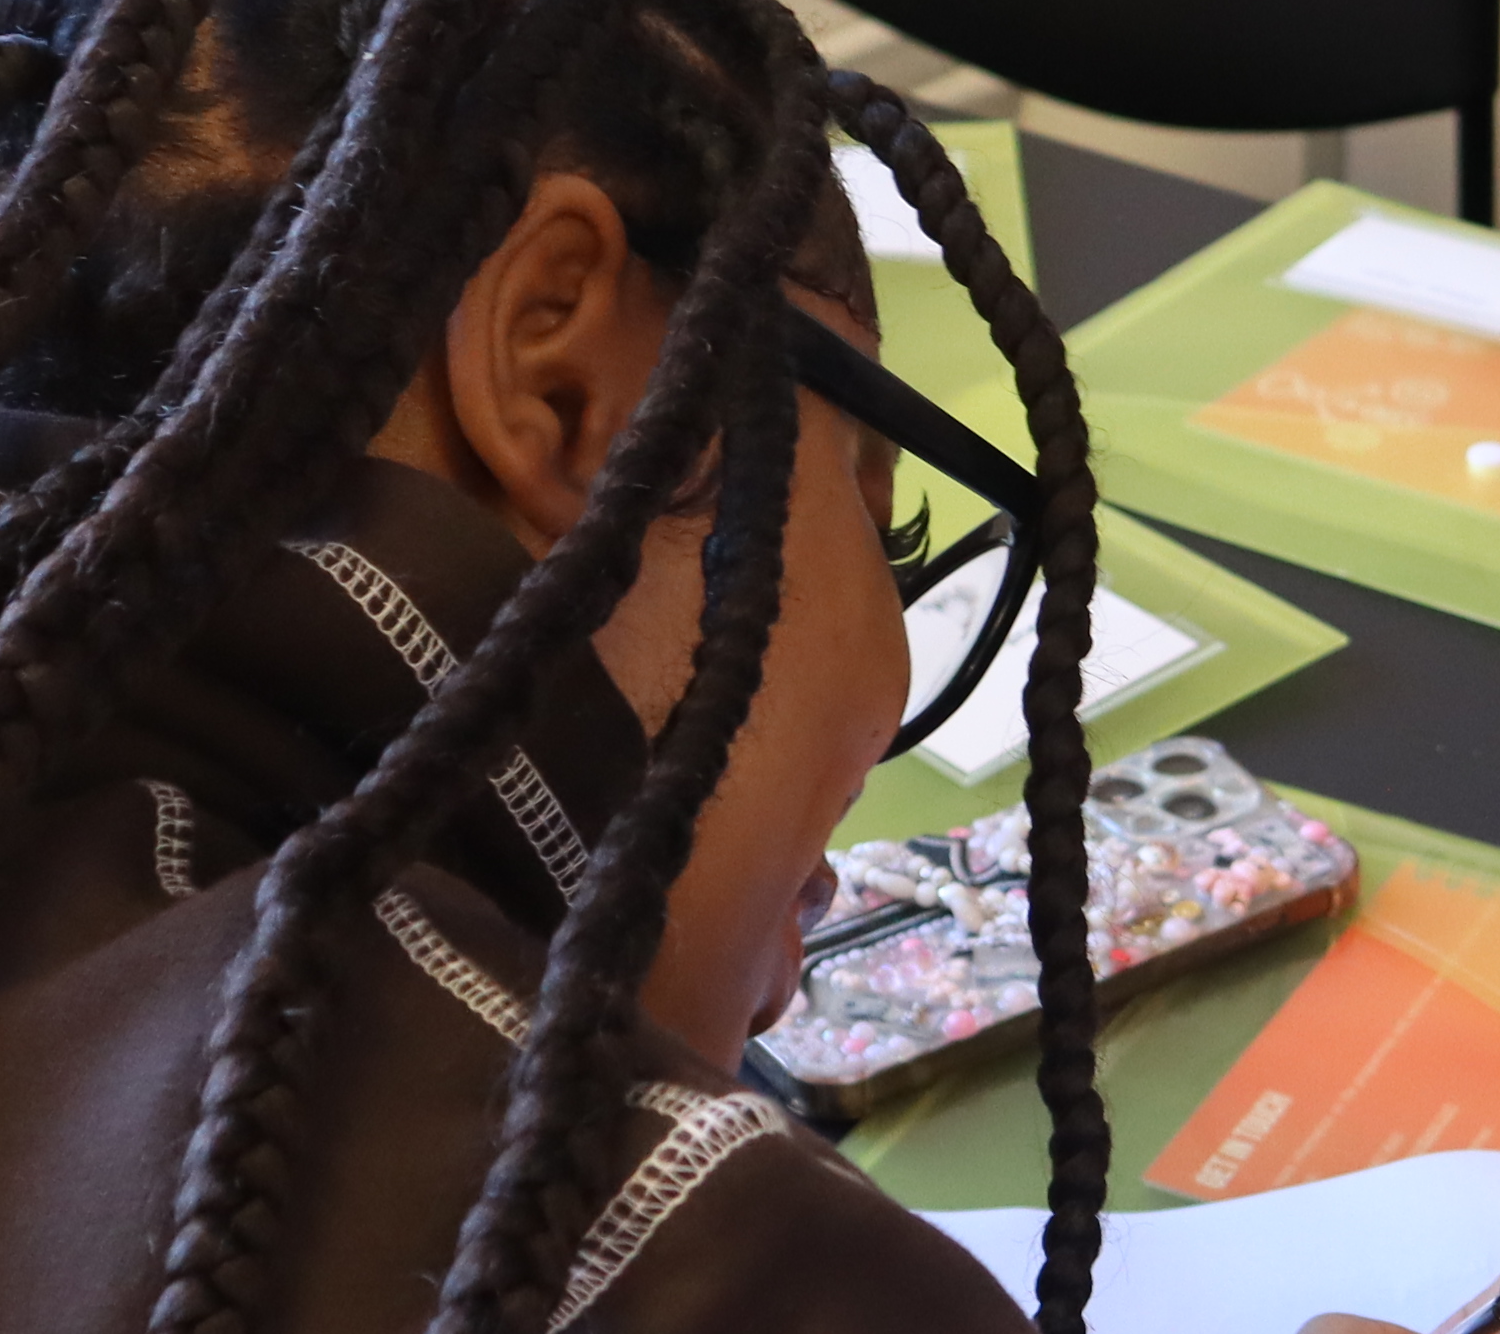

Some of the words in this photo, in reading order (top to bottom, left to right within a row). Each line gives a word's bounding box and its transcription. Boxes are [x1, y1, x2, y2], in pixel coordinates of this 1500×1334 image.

[1230, 1089, 1293, 1142] TOUCH
[1218, 1138, 1255, 1161] IN
[1195, 1153, 1239, 1189] GET
